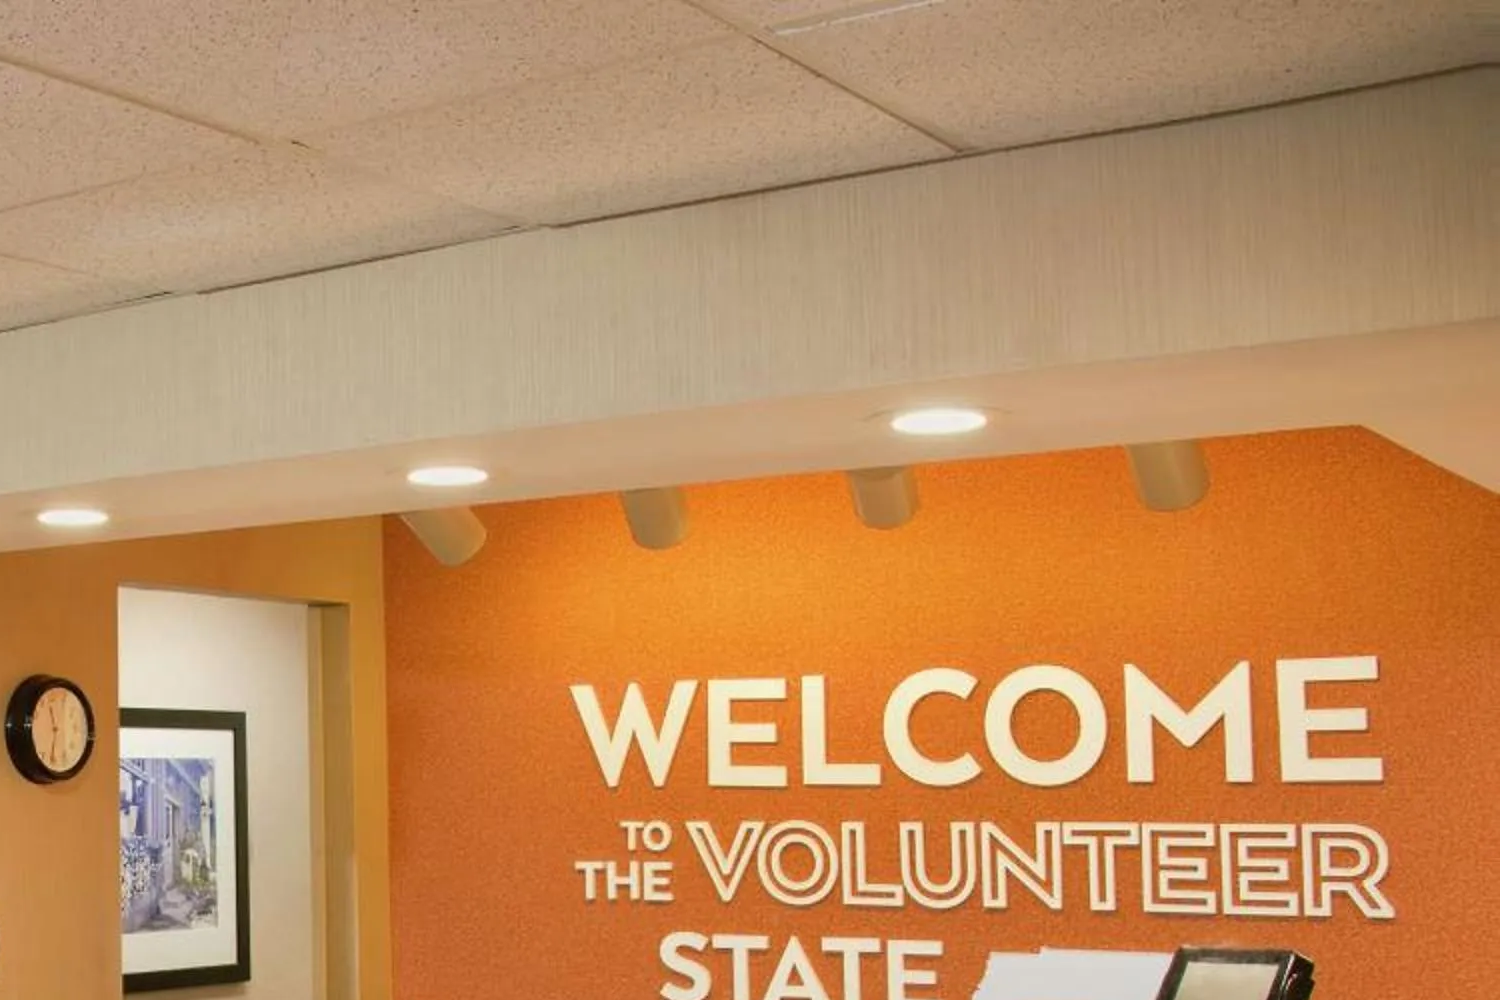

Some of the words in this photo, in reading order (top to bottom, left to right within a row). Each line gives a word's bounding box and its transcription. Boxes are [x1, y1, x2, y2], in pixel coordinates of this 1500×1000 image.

[570, 655, 1384, 788] WELCOME
[621, 820, 672, 853] TO
[686, 819, 1395, 919] VOLUNTEER
[575, 860, 674, 902] THE
